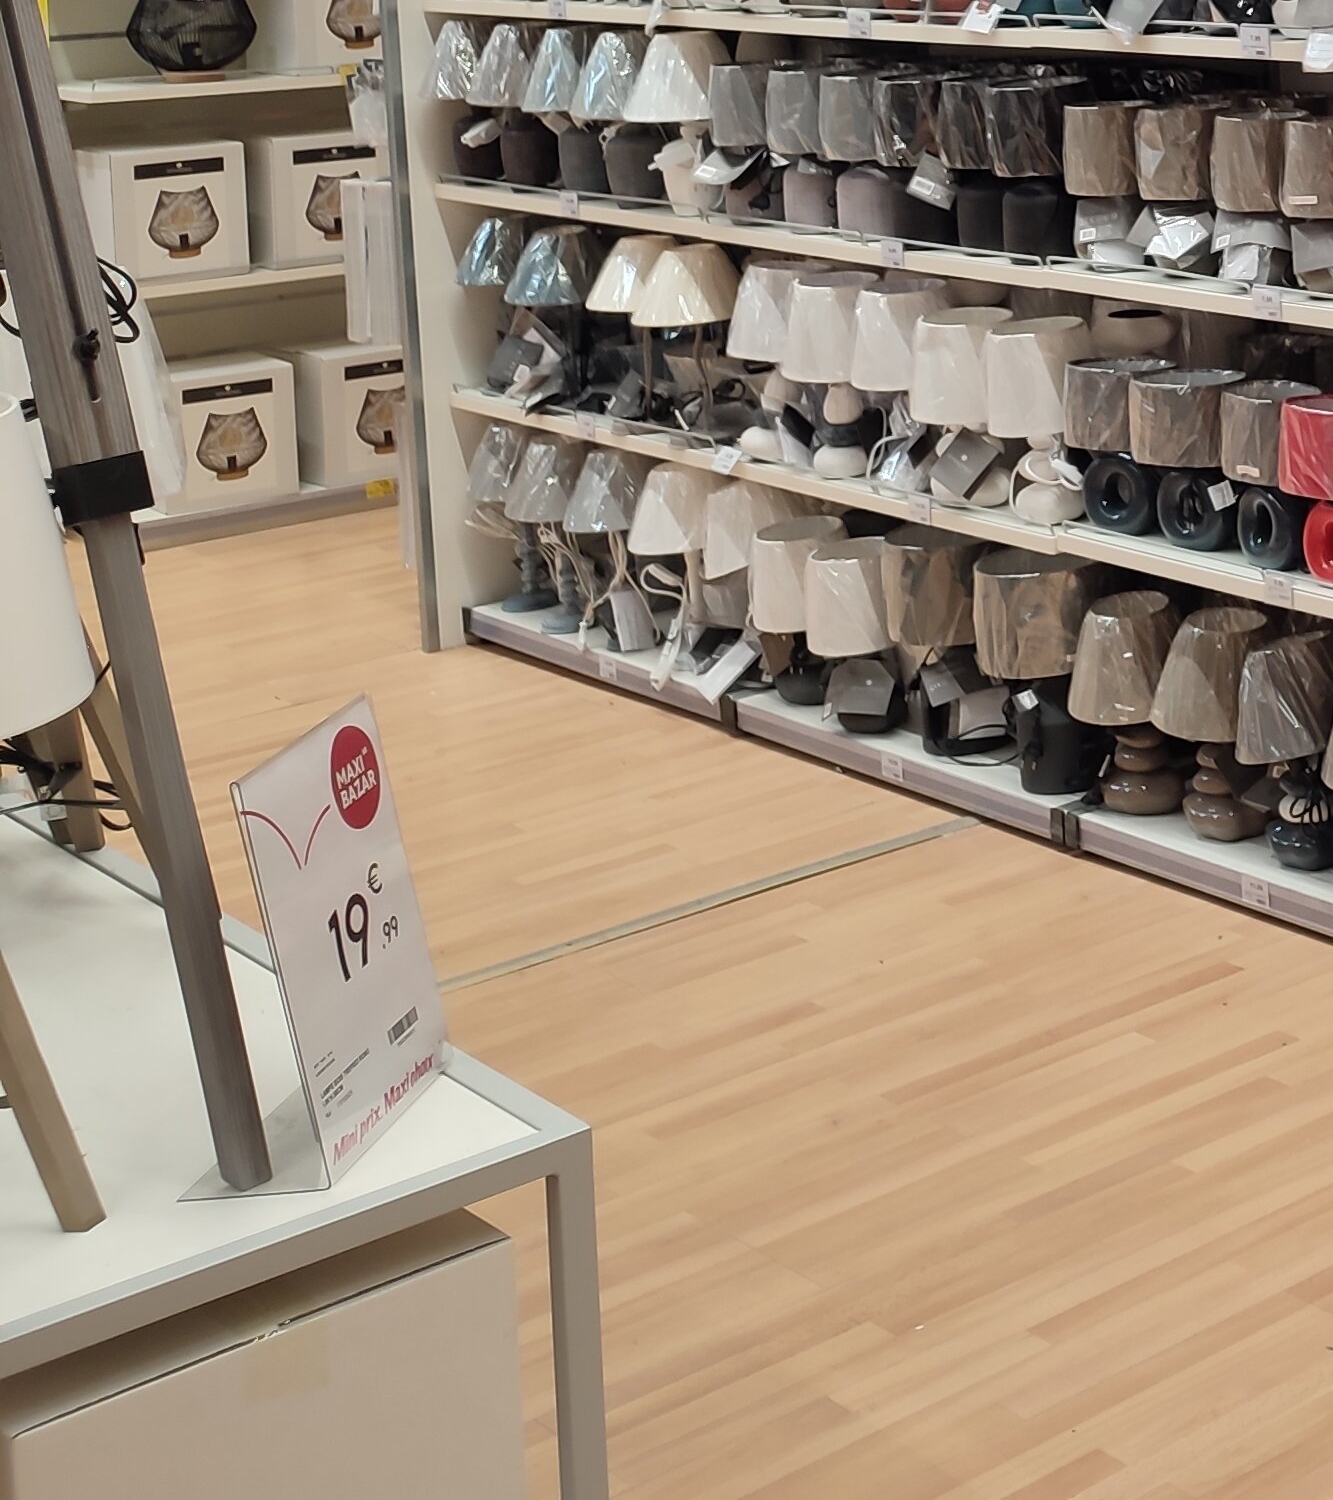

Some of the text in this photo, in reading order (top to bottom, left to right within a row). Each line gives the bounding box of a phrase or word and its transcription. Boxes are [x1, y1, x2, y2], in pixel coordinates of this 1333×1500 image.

[335, 755, 366, 790] MAXI
[339, 769, 378, 810] BAZAR
[328, 893, 369, 982] 19
[384, 1071, 410, 1114] Maxi
